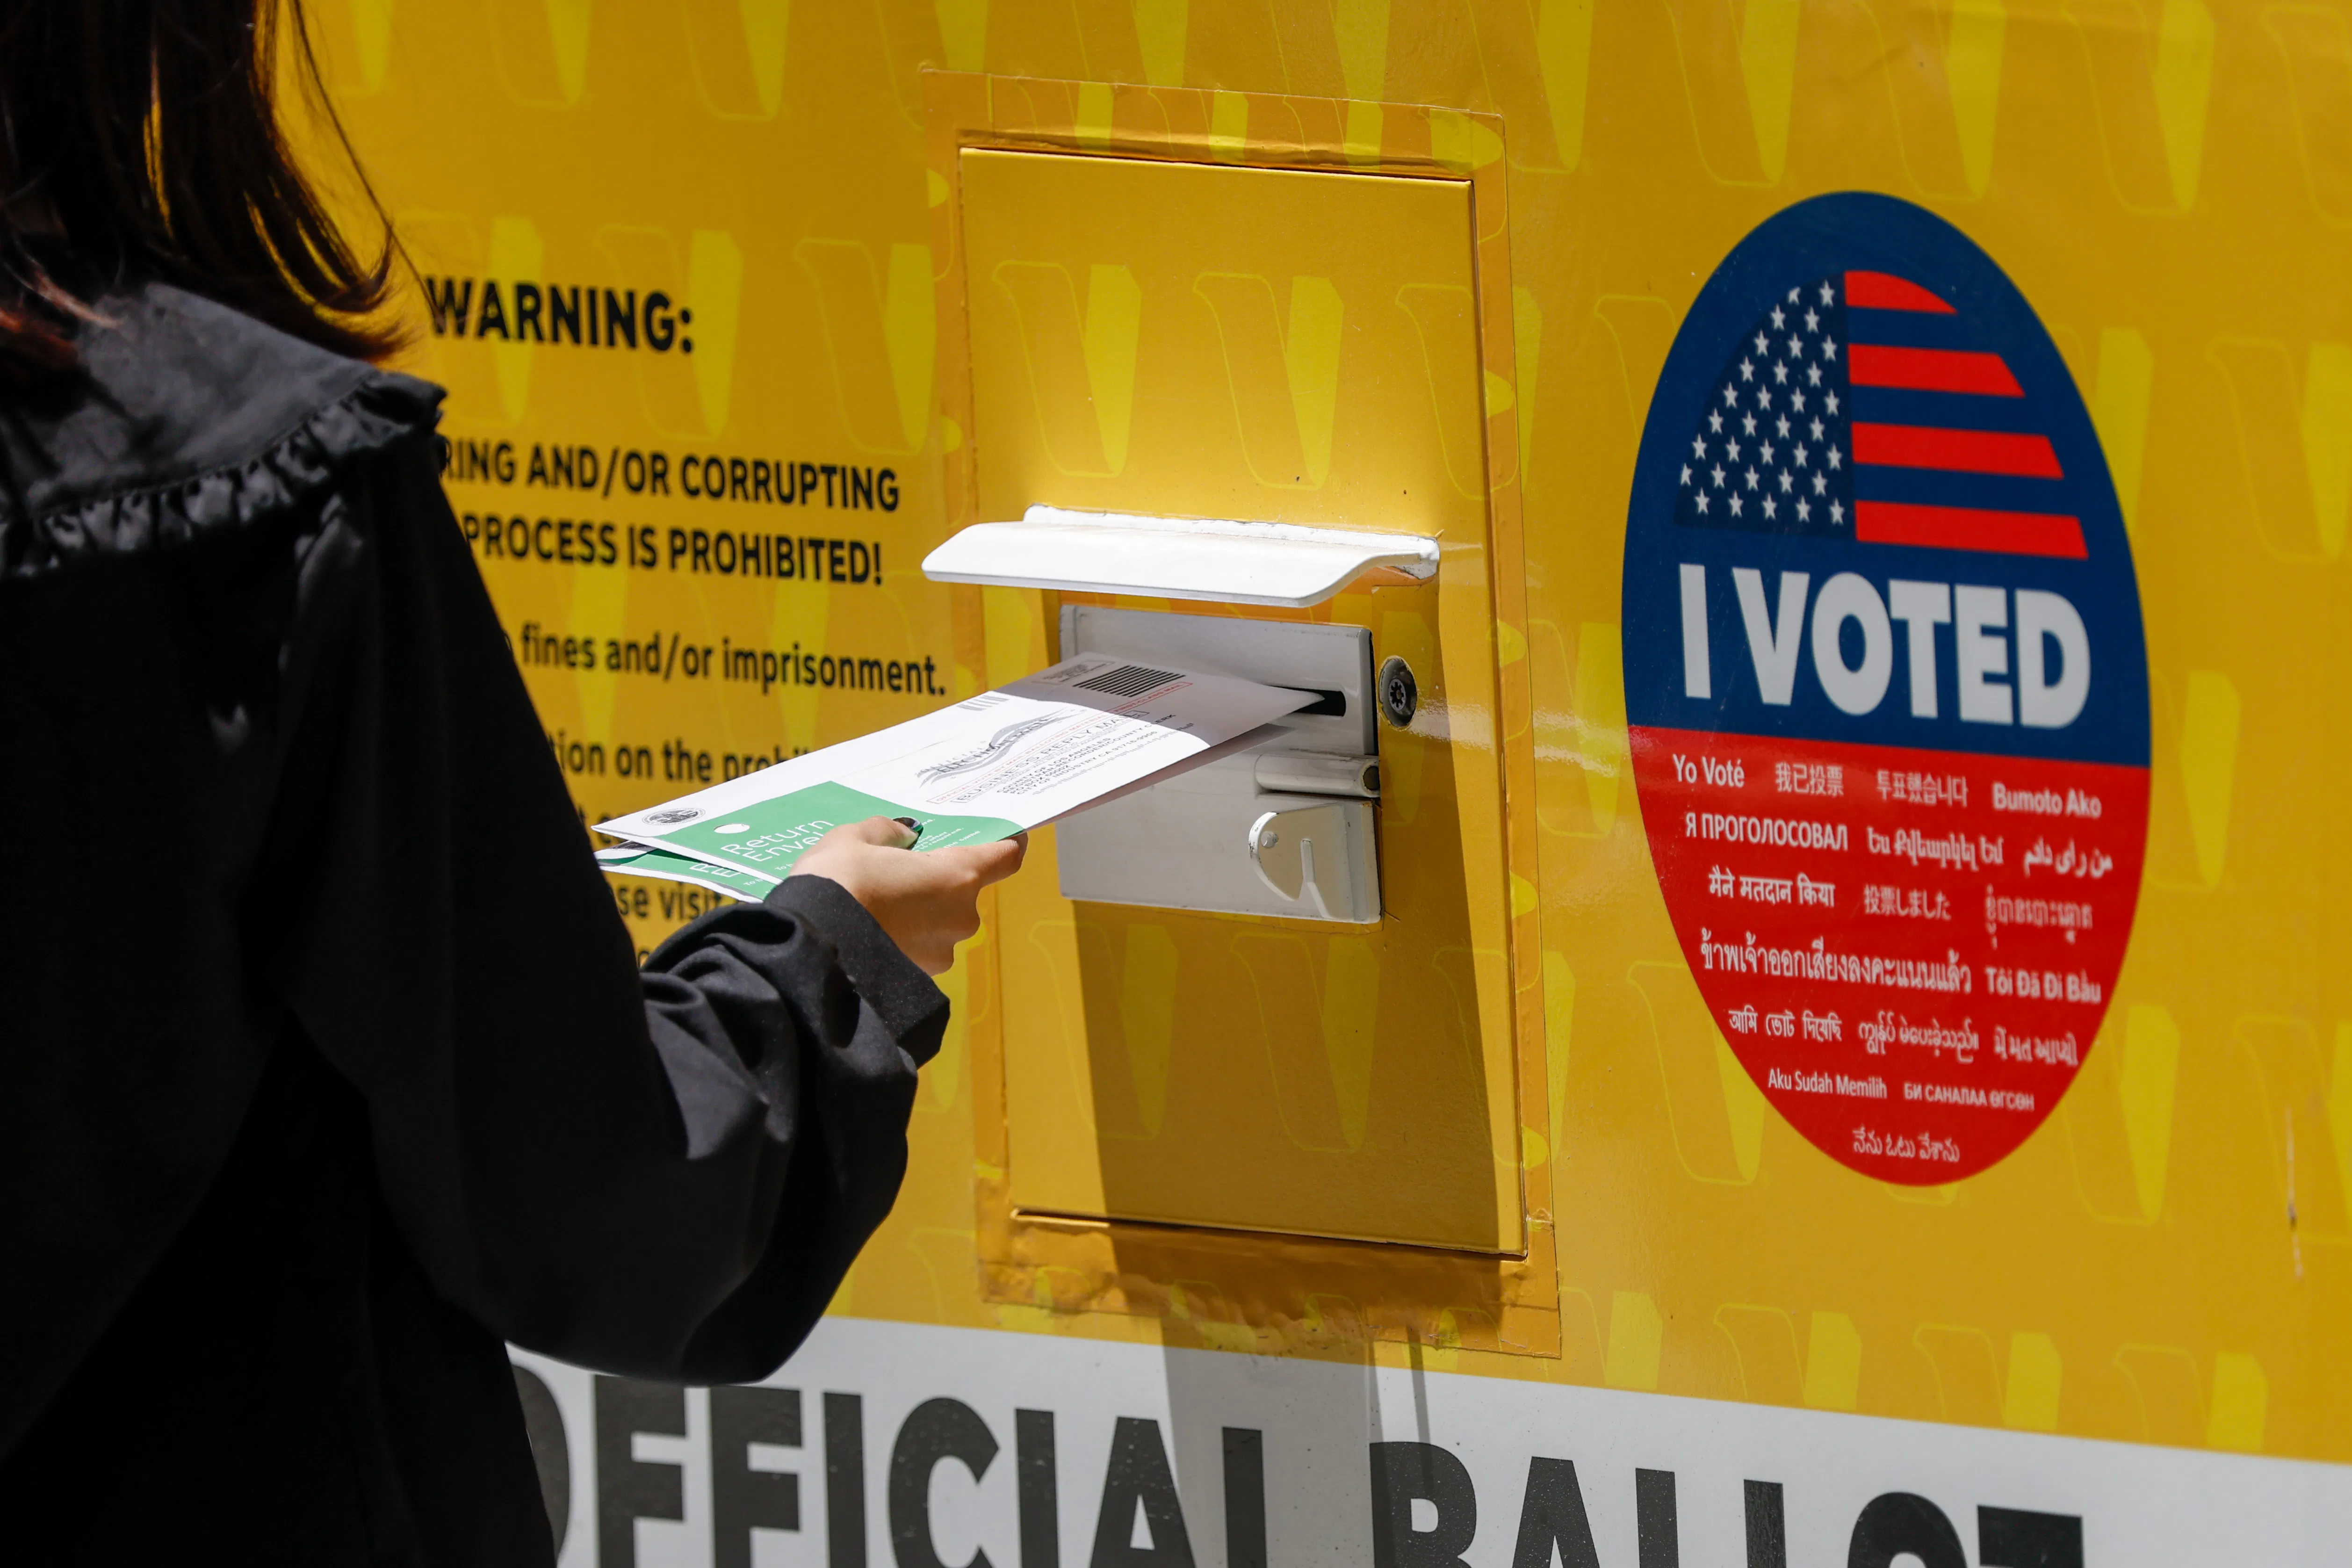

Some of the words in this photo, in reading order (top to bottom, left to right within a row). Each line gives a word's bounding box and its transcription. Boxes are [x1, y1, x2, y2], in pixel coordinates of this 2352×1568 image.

[427, 278, 694, 353] WARNING:
[527, 443, 671, 499] AND/OR
[680, 455, 899, 513] CORRUPTING
[464, 513, 617, 564] PROCESS
[628, 524, 658, 568] IS
[668, 528, 883, 586] PROHIBITED!
[521, 622, 596, 670] fines
[605, 631, 711, 681] and/or
[723, 637, 945, 697] imprisonment.
[1680, 564, 1711, 699] I
[1732, 567, 2091, 730] VOTED
[616, 746, 653, 780] on
[663, 737, 713, 783] the
[955, 757, 1041, 801] BUSINESS
[1039, 729, 1092, 754] REPLY
[1094, 714, 1138, 729] MAIL
[995, 773, 1033, 792] COUNTY
[1051, 757, 1068, 767] LOS
[1068, 737, 1111, 757] ANGELES
[1017, 784, 1037, 794] CITY
[1052, 757, 1096, 777] INDUSTRY
[1672, 753, 1697, 783] Yo
[1702, 756, 1745, 788] Voté
[1775, 761, 1844, 797] 我已投票
[1876, 769, 1968, 808] 투표했습니다
[1992, 781, 2063, 815] Bumoto
[2065, 787, 2102, 819] Ako
[720, 820, 835, 855] Return
[1685, 812, 1697, 838] Я
[1701, 812, 1848, 851] ПРОГОЛОСОВАЛ
[2090, 846, 2113, 879] من
[1739, 876, 1793, 904] मतदान
[1797, 871, 1835, 908] किया
[1863, 884, 1951, 921] 投票しました
[1701, 927, 1971, 994] ข้าพเจ้าออกเสียงลงคะแนนแล้ว
[1984, 966, 2013, 997] Tôi
[1728, 1005, 1758, 1033] আমি
[1766, 1009, 1795, 1037] ভোট
[1768, 1067, 1792, 1090] Aku
[1795, 1070, 1833, 1094] Sudah
[1836, 1074, 1888, 1099] Memilih
[1904, 1082, 1922, 1100] БИ
